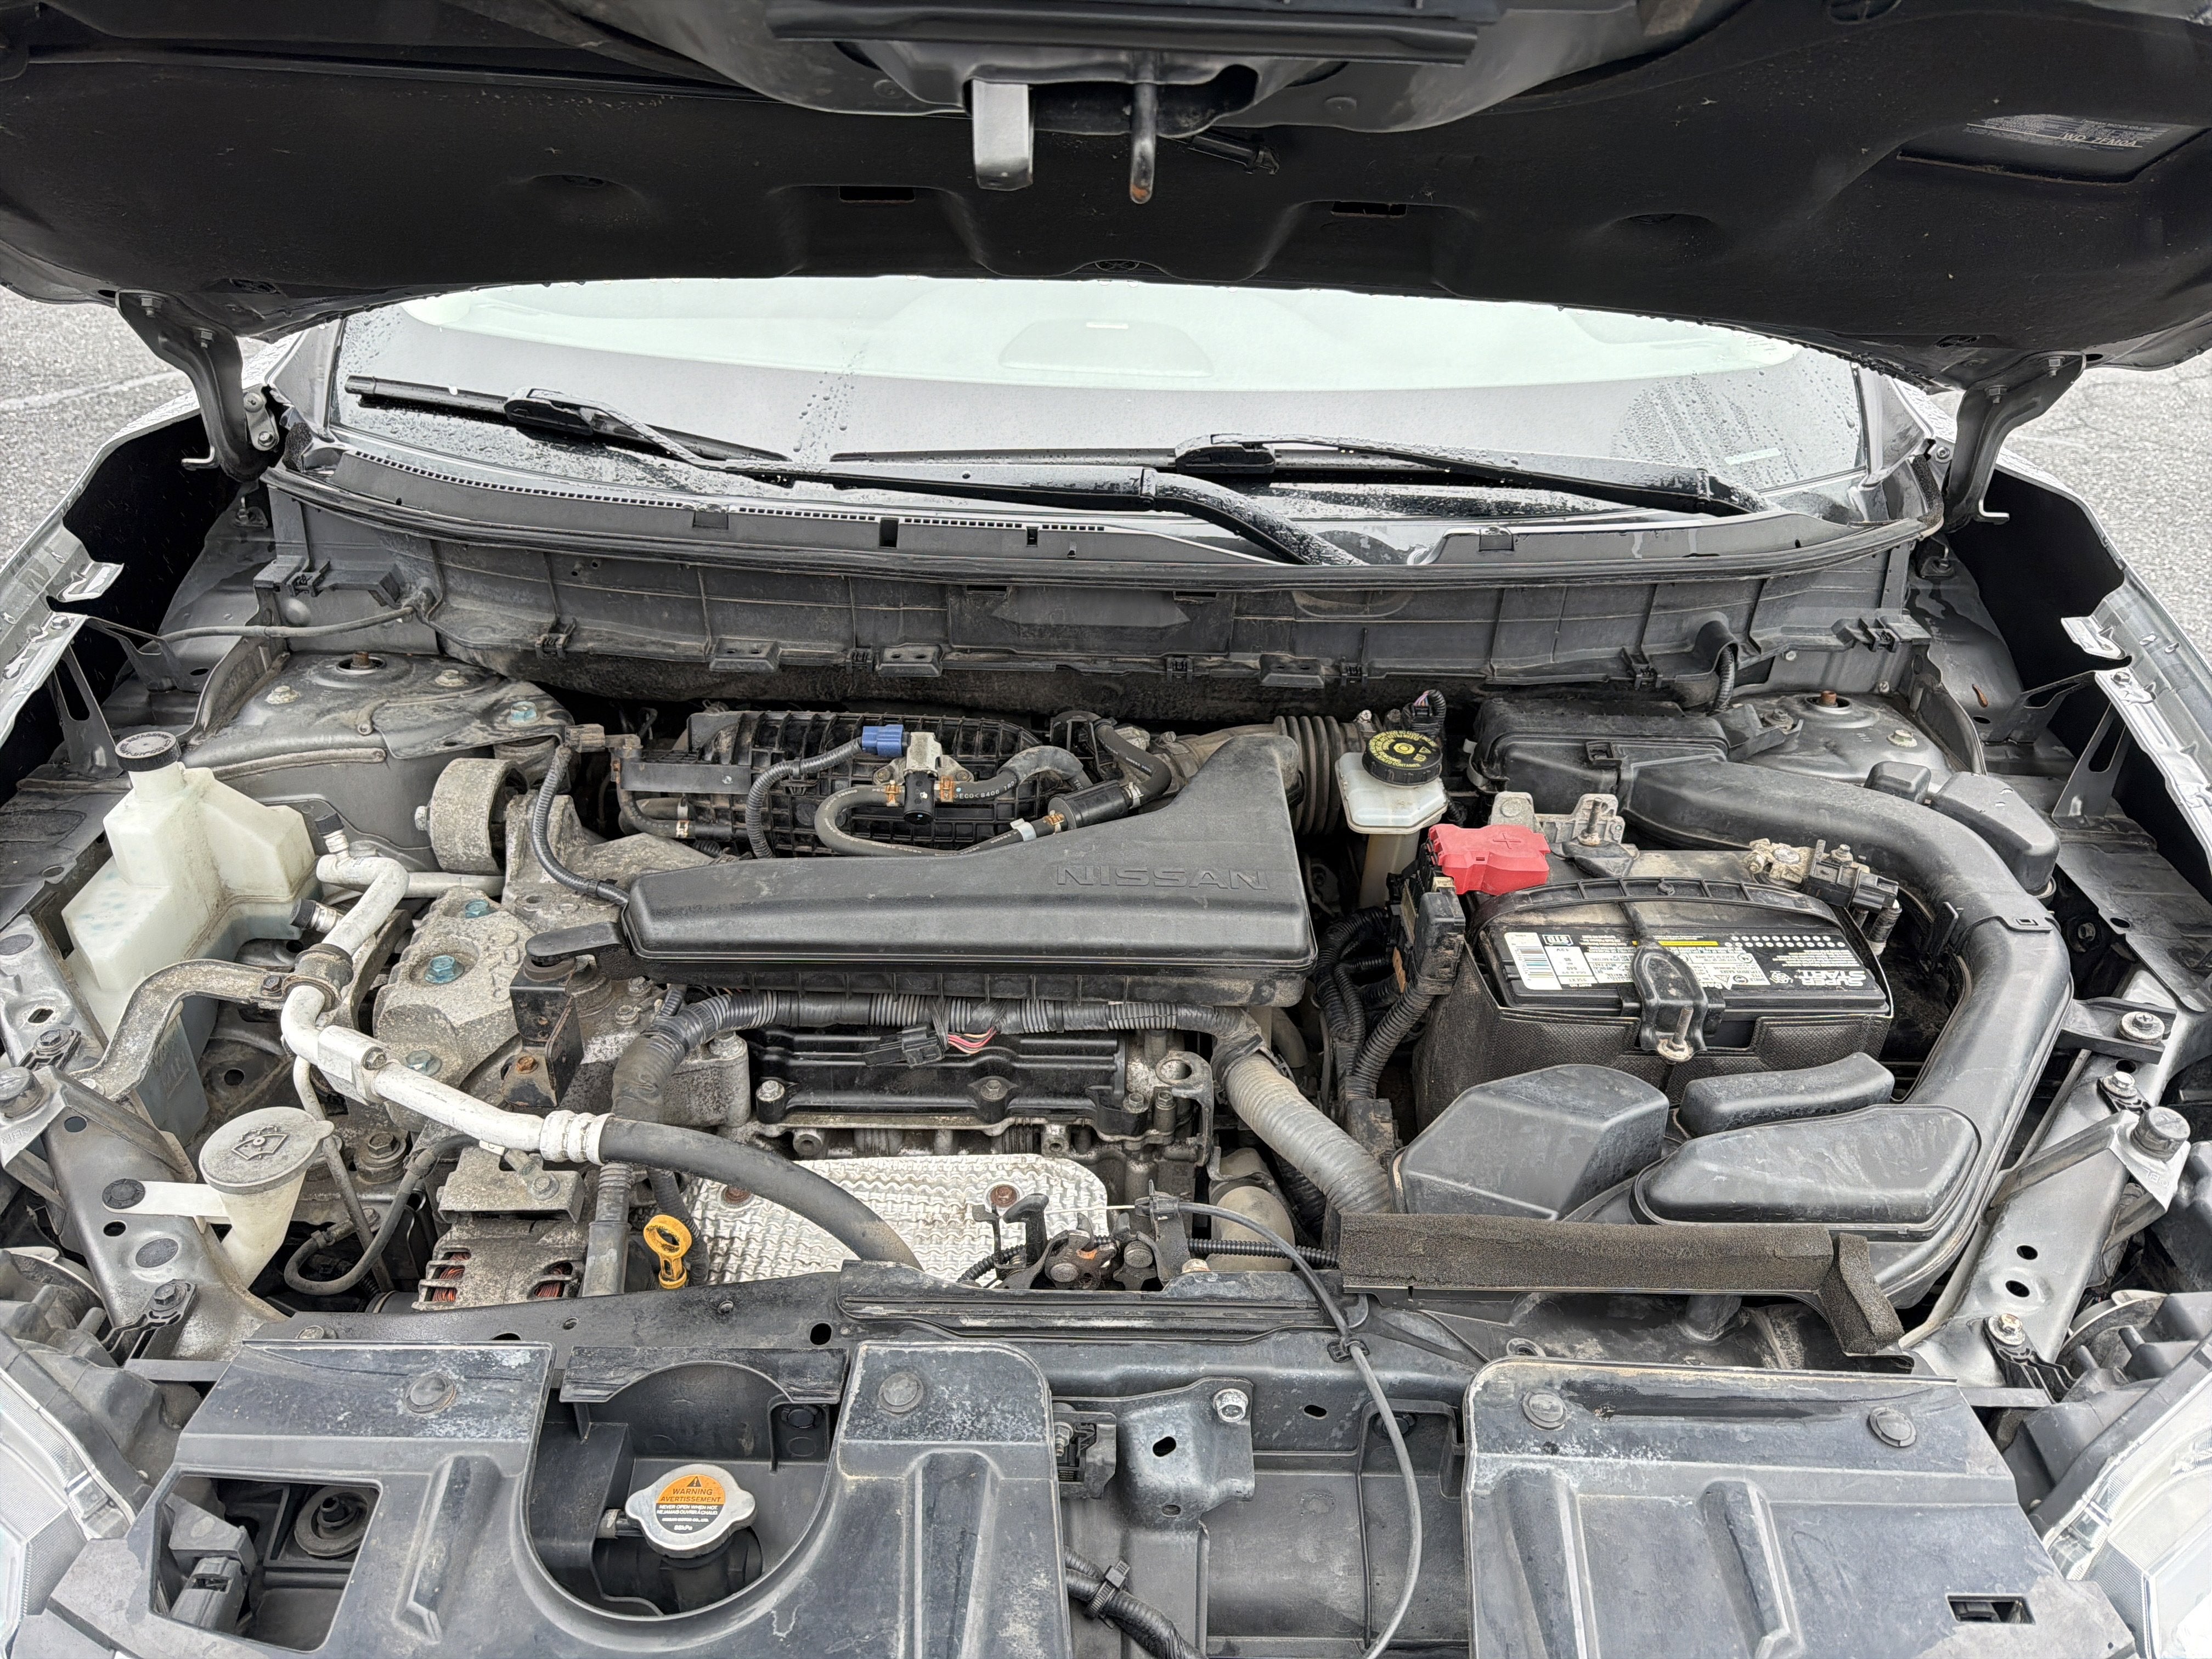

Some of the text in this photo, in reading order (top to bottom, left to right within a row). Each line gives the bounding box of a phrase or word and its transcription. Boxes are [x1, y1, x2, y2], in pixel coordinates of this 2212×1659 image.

[1057, 865, 1268, 890] NISSAN
[1798, 970, 1866, 979] START
[1801, 978, 1864, 986] SUPER
